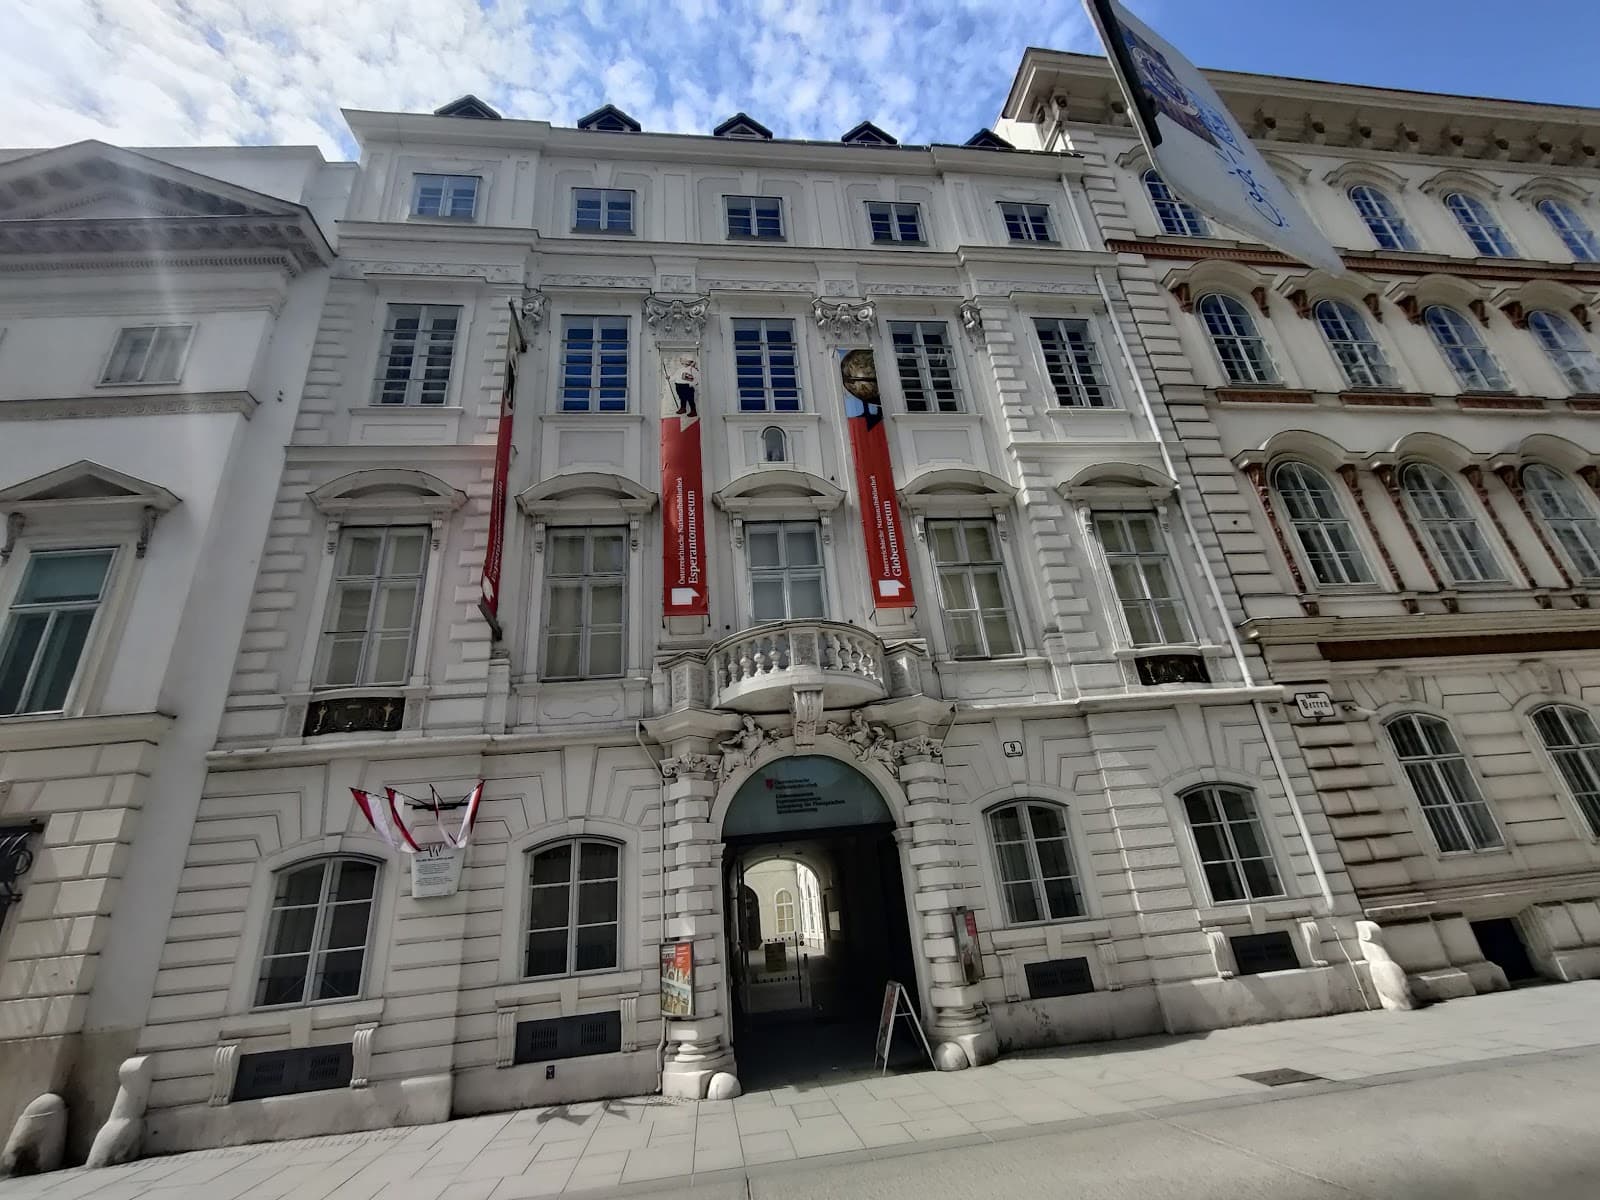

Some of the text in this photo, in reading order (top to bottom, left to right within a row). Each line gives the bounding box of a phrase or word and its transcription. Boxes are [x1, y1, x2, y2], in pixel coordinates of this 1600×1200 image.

[687, 490, 700, 585] Esperantomuseum
[883, 500, 902, 577] Globenmuseum
[1010, 743, 1016, 752] 9
